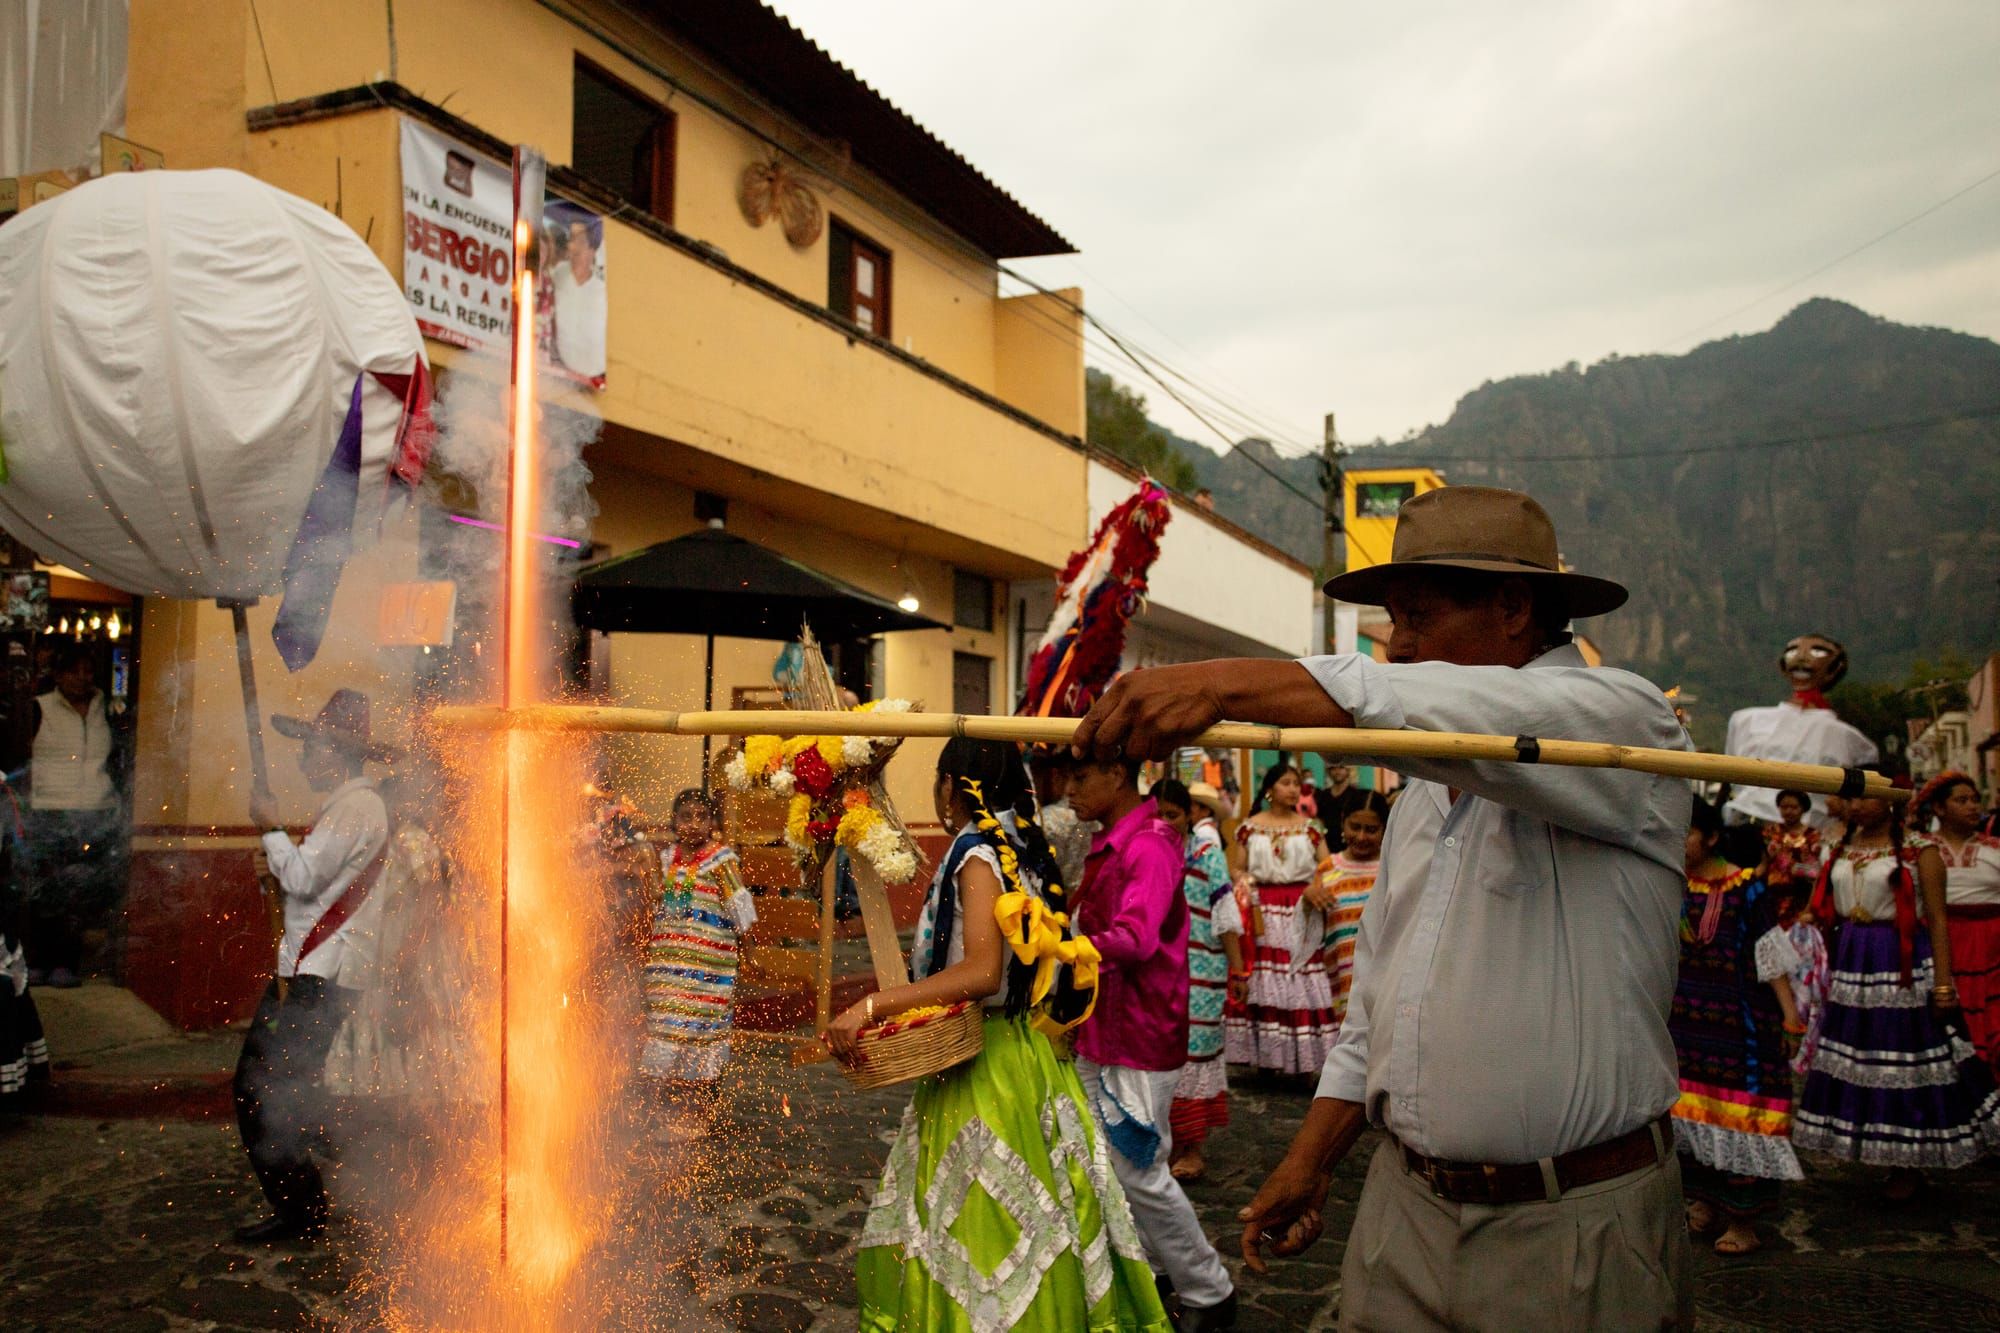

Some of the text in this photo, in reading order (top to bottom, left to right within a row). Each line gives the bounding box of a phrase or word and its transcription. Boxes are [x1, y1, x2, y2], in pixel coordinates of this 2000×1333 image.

[423, 194, 440, 213] LA
[406, 211, 510, 287] SERGIO
[406, 257, 509, 312] ARGAS
[430, 294, 451, 318] LA
